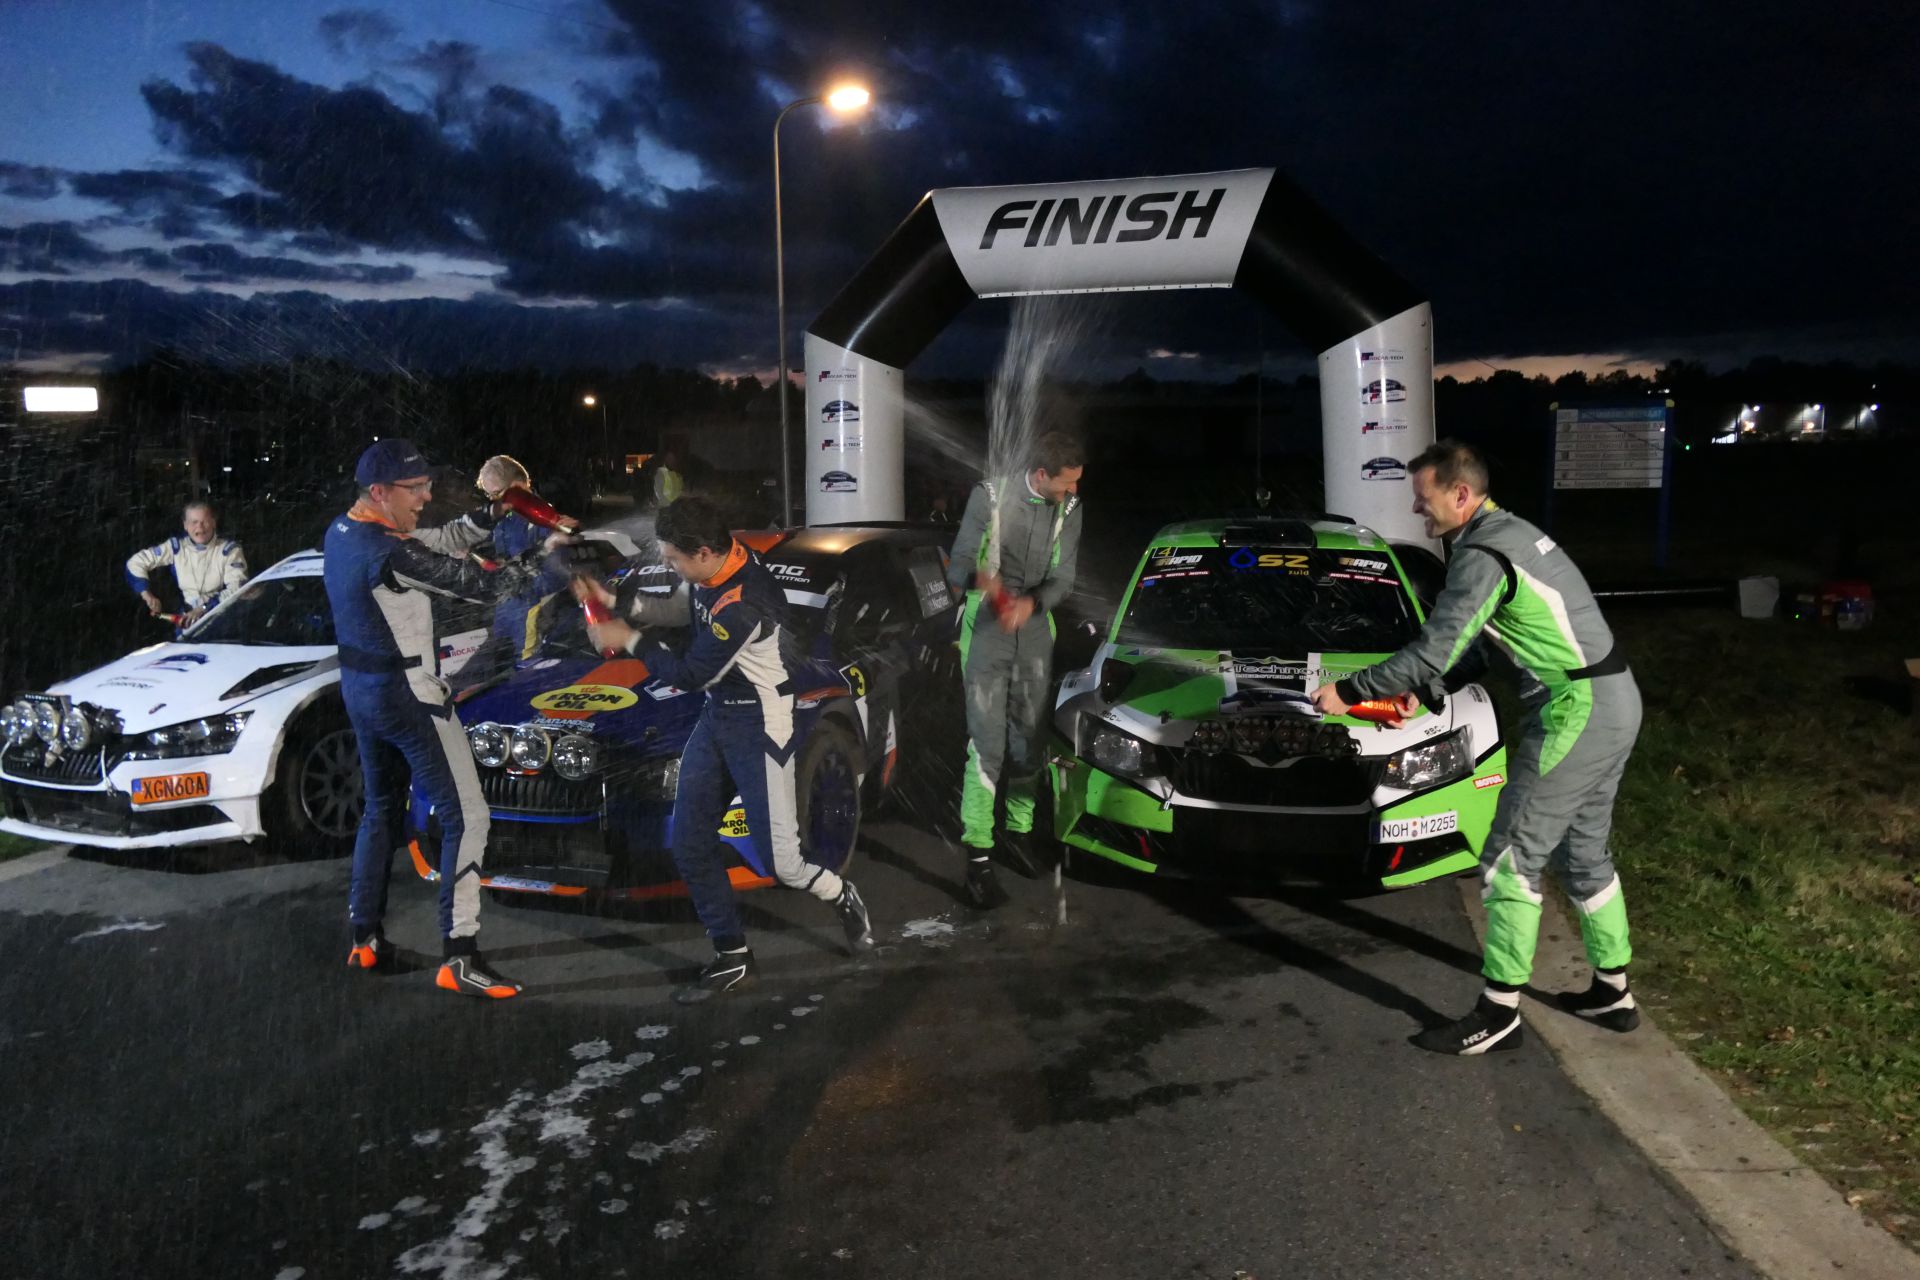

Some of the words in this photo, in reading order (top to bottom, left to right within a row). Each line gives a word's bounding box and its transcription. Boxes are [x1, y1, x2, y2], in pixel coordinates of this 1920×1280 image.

[979, 188, 1226, 250] FINISH
[553, 700, 588, 710] OIL
[1474, 774, 1504, 788] MOTUL
[733, 826, 749, 835] OIL
[1382, 822, 1409, 838] NOH
[1420, 820, 1428, 835] M
[1429, 815, 1456, 833] 2255
[1462, 1028, 1490, 1047] HRX
